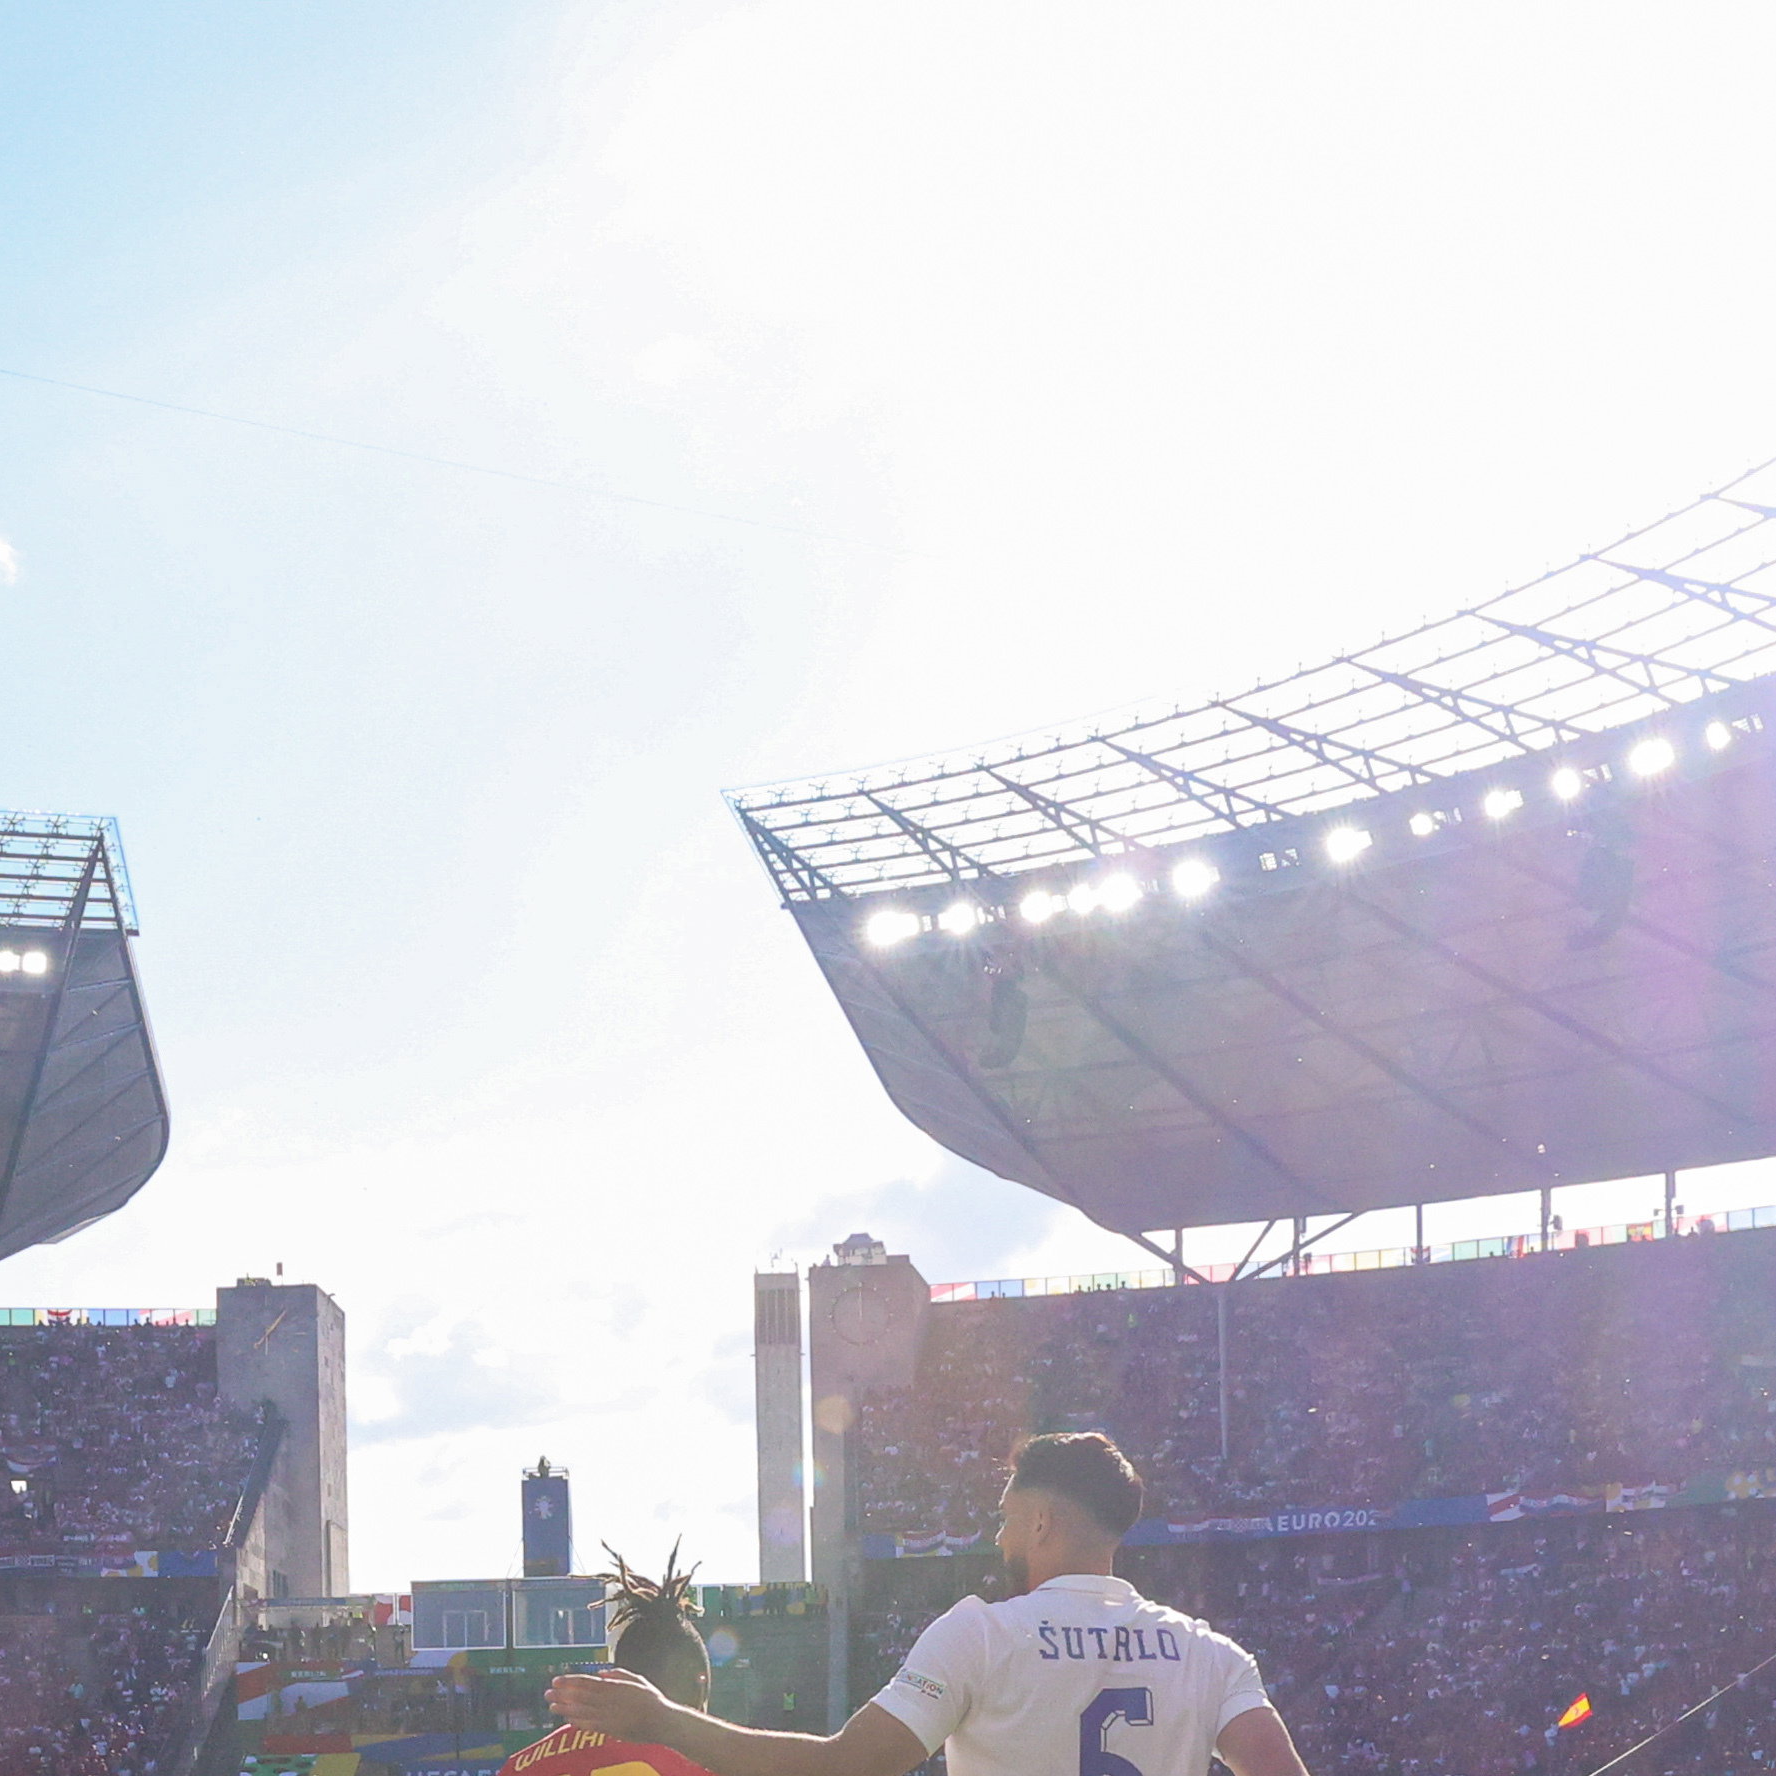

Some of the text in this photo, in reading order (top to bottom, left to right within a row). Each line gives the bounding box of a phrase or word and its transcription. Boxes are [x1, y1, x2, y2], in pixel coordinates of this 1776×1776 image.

[1277, 1509, 1376, 1532] EURO 202
[1038, 1620, 1181, 1662] ŠUTALO
[515, 1729, 606, 1772] WILLIA
